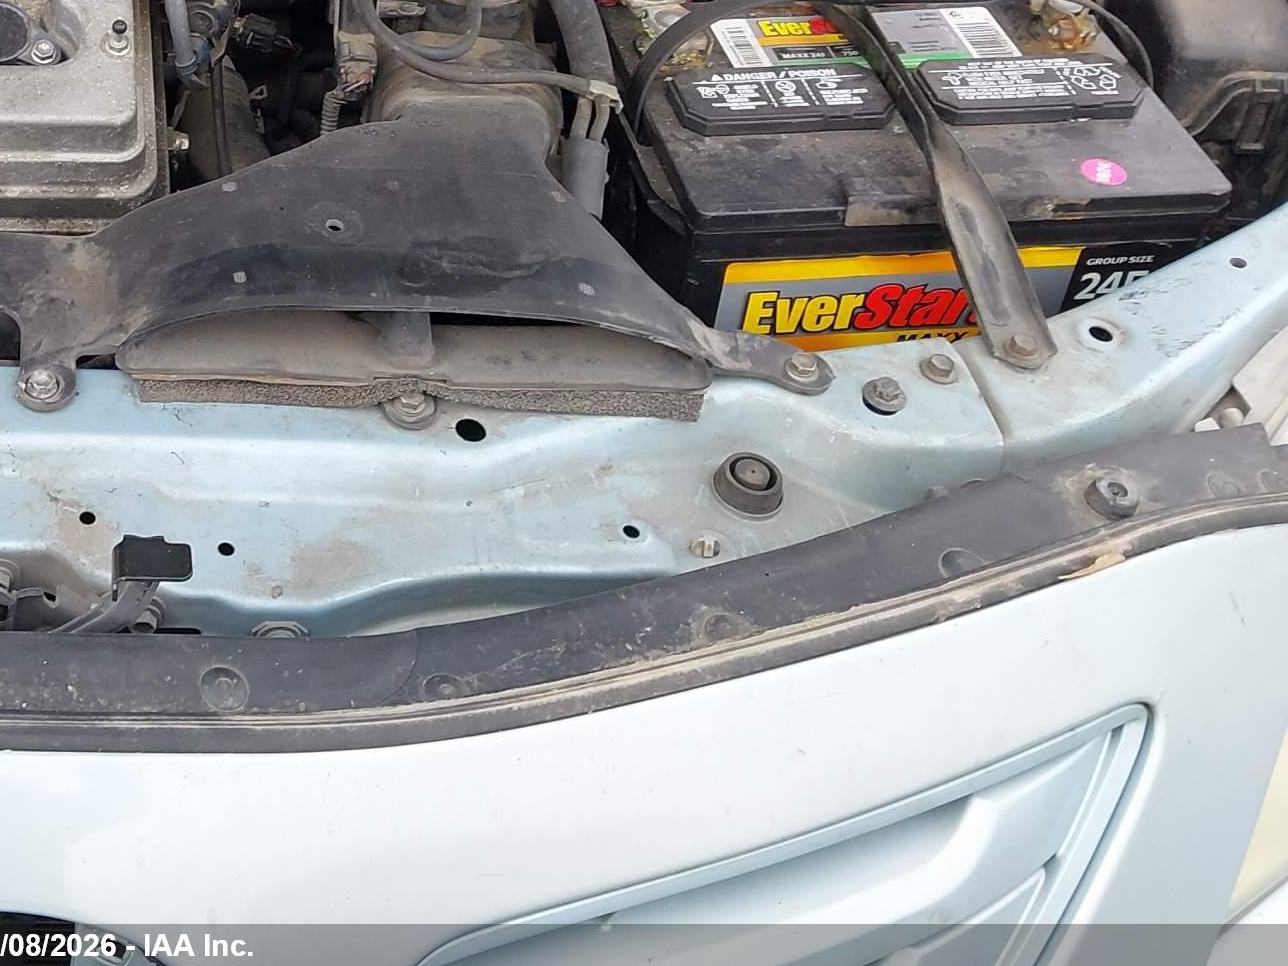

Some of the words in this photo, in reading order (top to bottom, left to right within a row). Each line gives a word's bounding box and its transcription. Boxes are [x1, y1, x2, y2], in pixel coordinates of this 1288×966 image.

[722, 70, 778, 82] DANGER
[788, 68, 837, 78] POISON
[1086, 256, 1128, 267] GROUP
[1128, 254, 1156, 264] SIZE
[742, 283, 977, 335] EverStar
